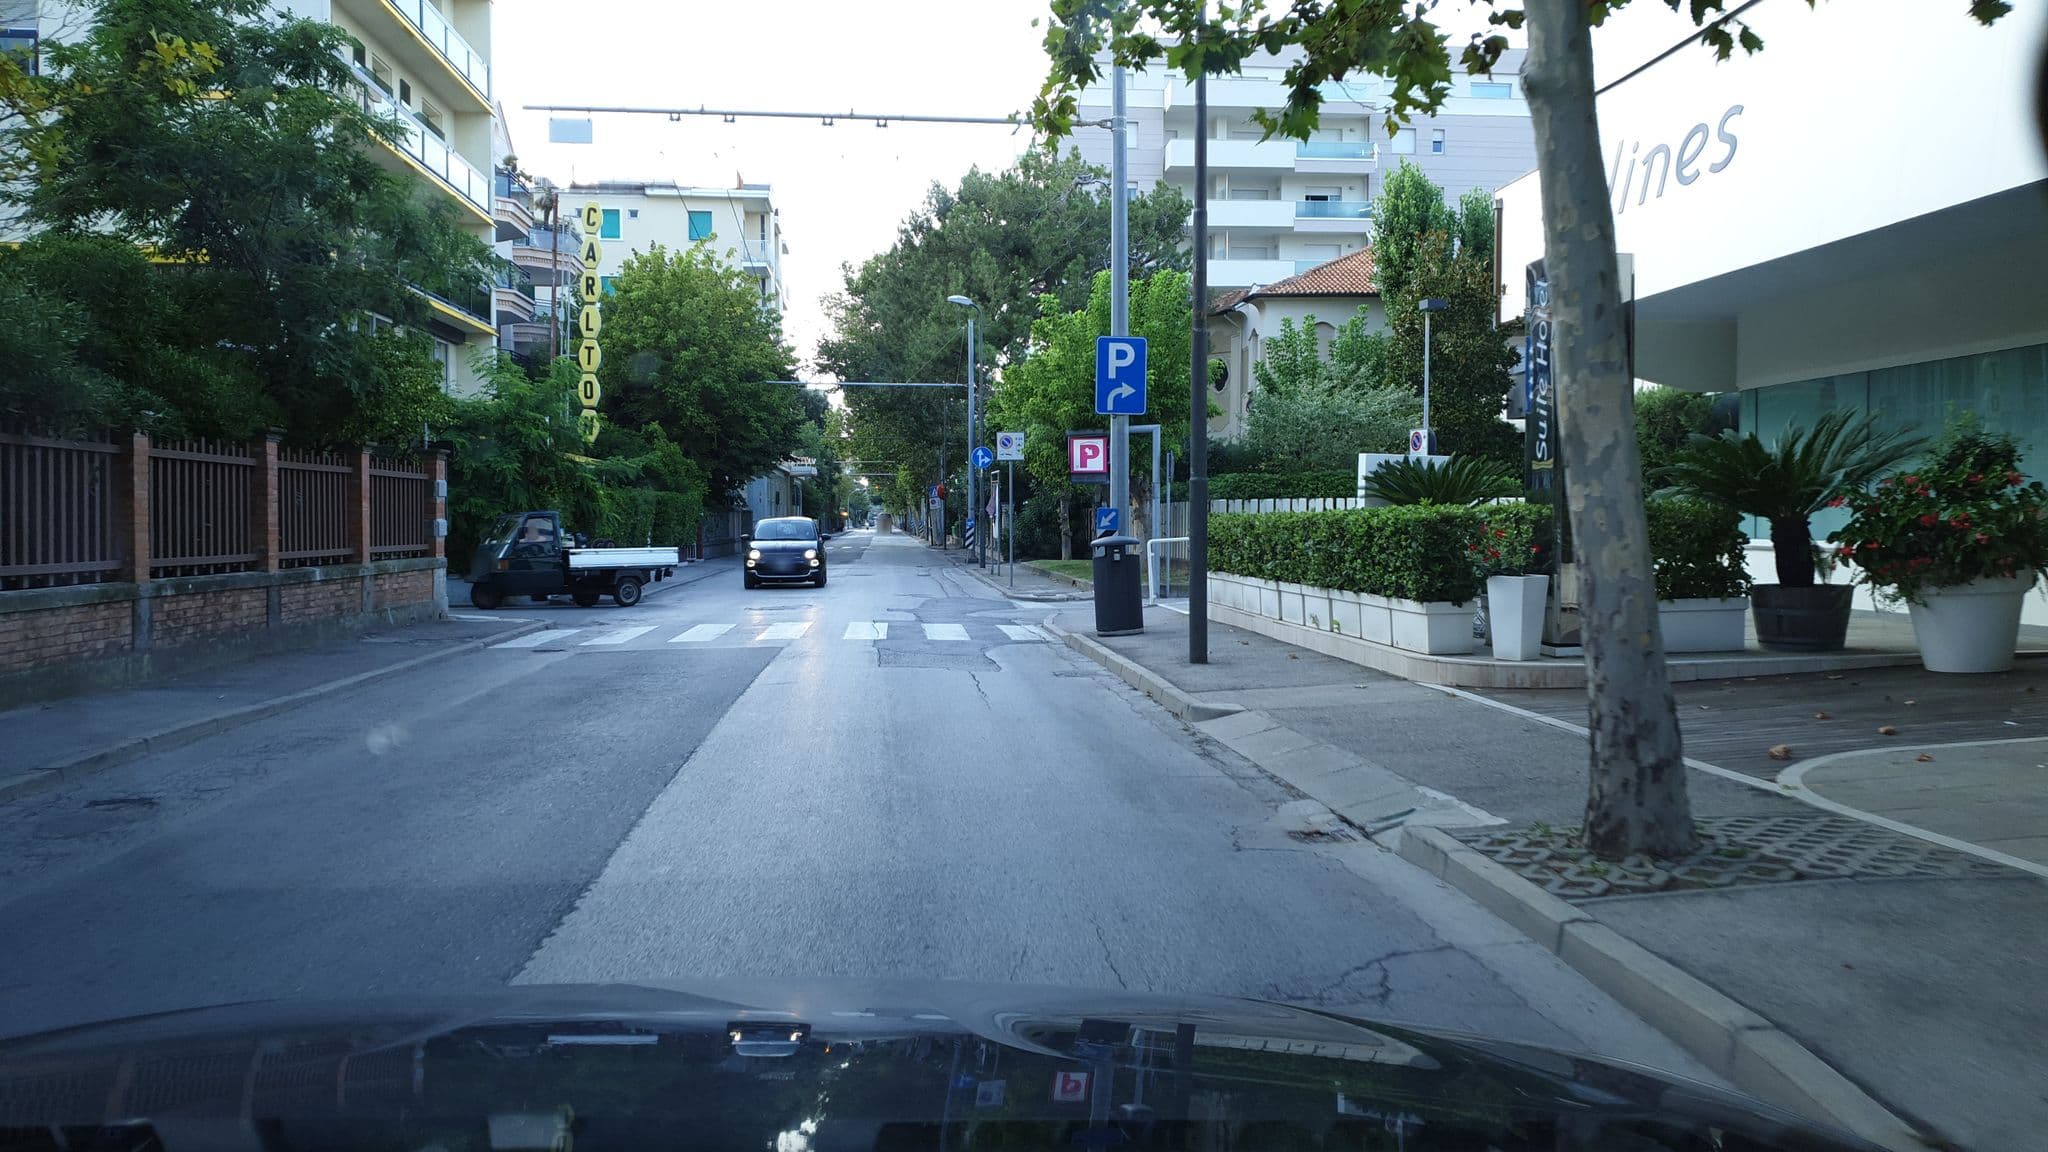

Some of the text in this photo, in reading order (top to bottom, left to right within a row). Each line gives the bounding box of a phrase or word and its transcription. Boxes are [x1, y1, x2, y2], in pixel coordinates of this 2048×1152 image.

[1535, 279, 1549, 367] Hotel
[1108, 342, 1136, 380] P
[1535, 377, 1549, 462] Suite
[1079, 444, 1101, 469] P
